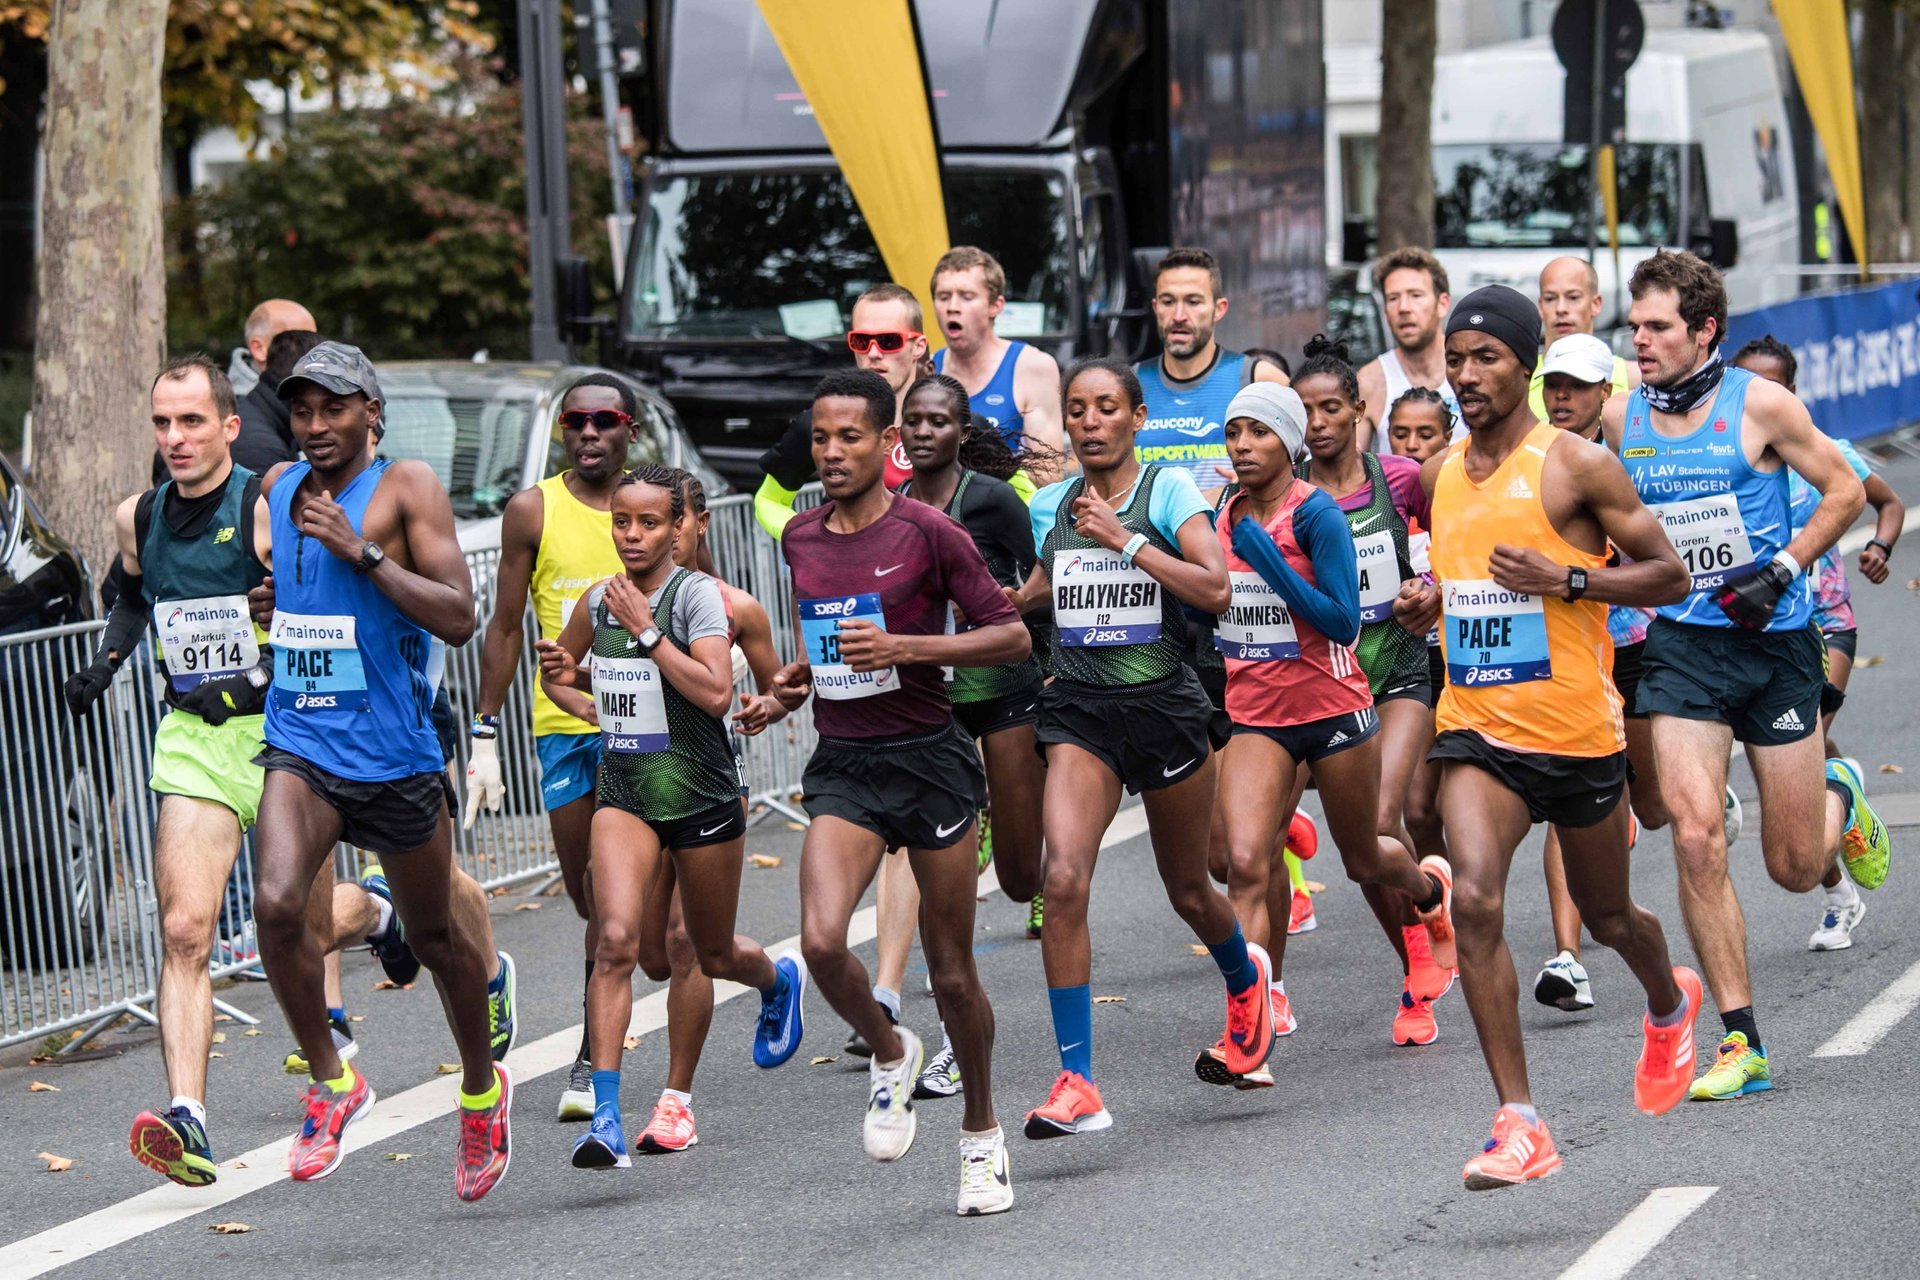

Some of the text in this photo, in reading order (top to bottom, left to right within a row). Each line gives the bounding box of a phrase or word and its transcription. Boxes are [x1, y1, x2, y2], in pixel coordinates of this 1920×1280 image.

[1142, 416, 1204, 431] saucony
[1649, 464, 1730, 478] LAV Stadtwerke
[1651, 479, 1731, 494] TÜBINGEN
[1664, 506, 1729, 526] mainova
[1675, 535, 1710, 548] Lorenz
[1230, 580, 1276, 595] ainova
[1695, 574, 1725, 590] asics
[1057, 582, 1157, 611] BELAYNESH
[1457, 589, 1530, 606] mainova
[184, 607, 239, 622] mainova
[1096, 613, 1111, 626] F12
[191, 632, 227, 644] Markus
[286, 624, 344, 640] mainova
[1095, 629, 1128, 642] asics
[1245, 632, 1254, 643] F3
[1458, 616, 1513, 649] PACE
[182, 642, 243, 671] 9114
[1247, 647, 1271, 658] asics
[1478, 651, 1491, 664] 70
[286, 648, 334, 678] PACE
[598, 667, 651, 682] mainova
[814, 671, 874, 690] mainova
[1477, 668, 1513, 682] asics
[305, 680, 317, 692] 84
[306, 695, 338, 708] asics
[601, 691, 637, 718] MARE
[614, 721, 622, 733] F2
[1772, 721, 1805, 731] adidas
[614, 737, 639, 750] asics
